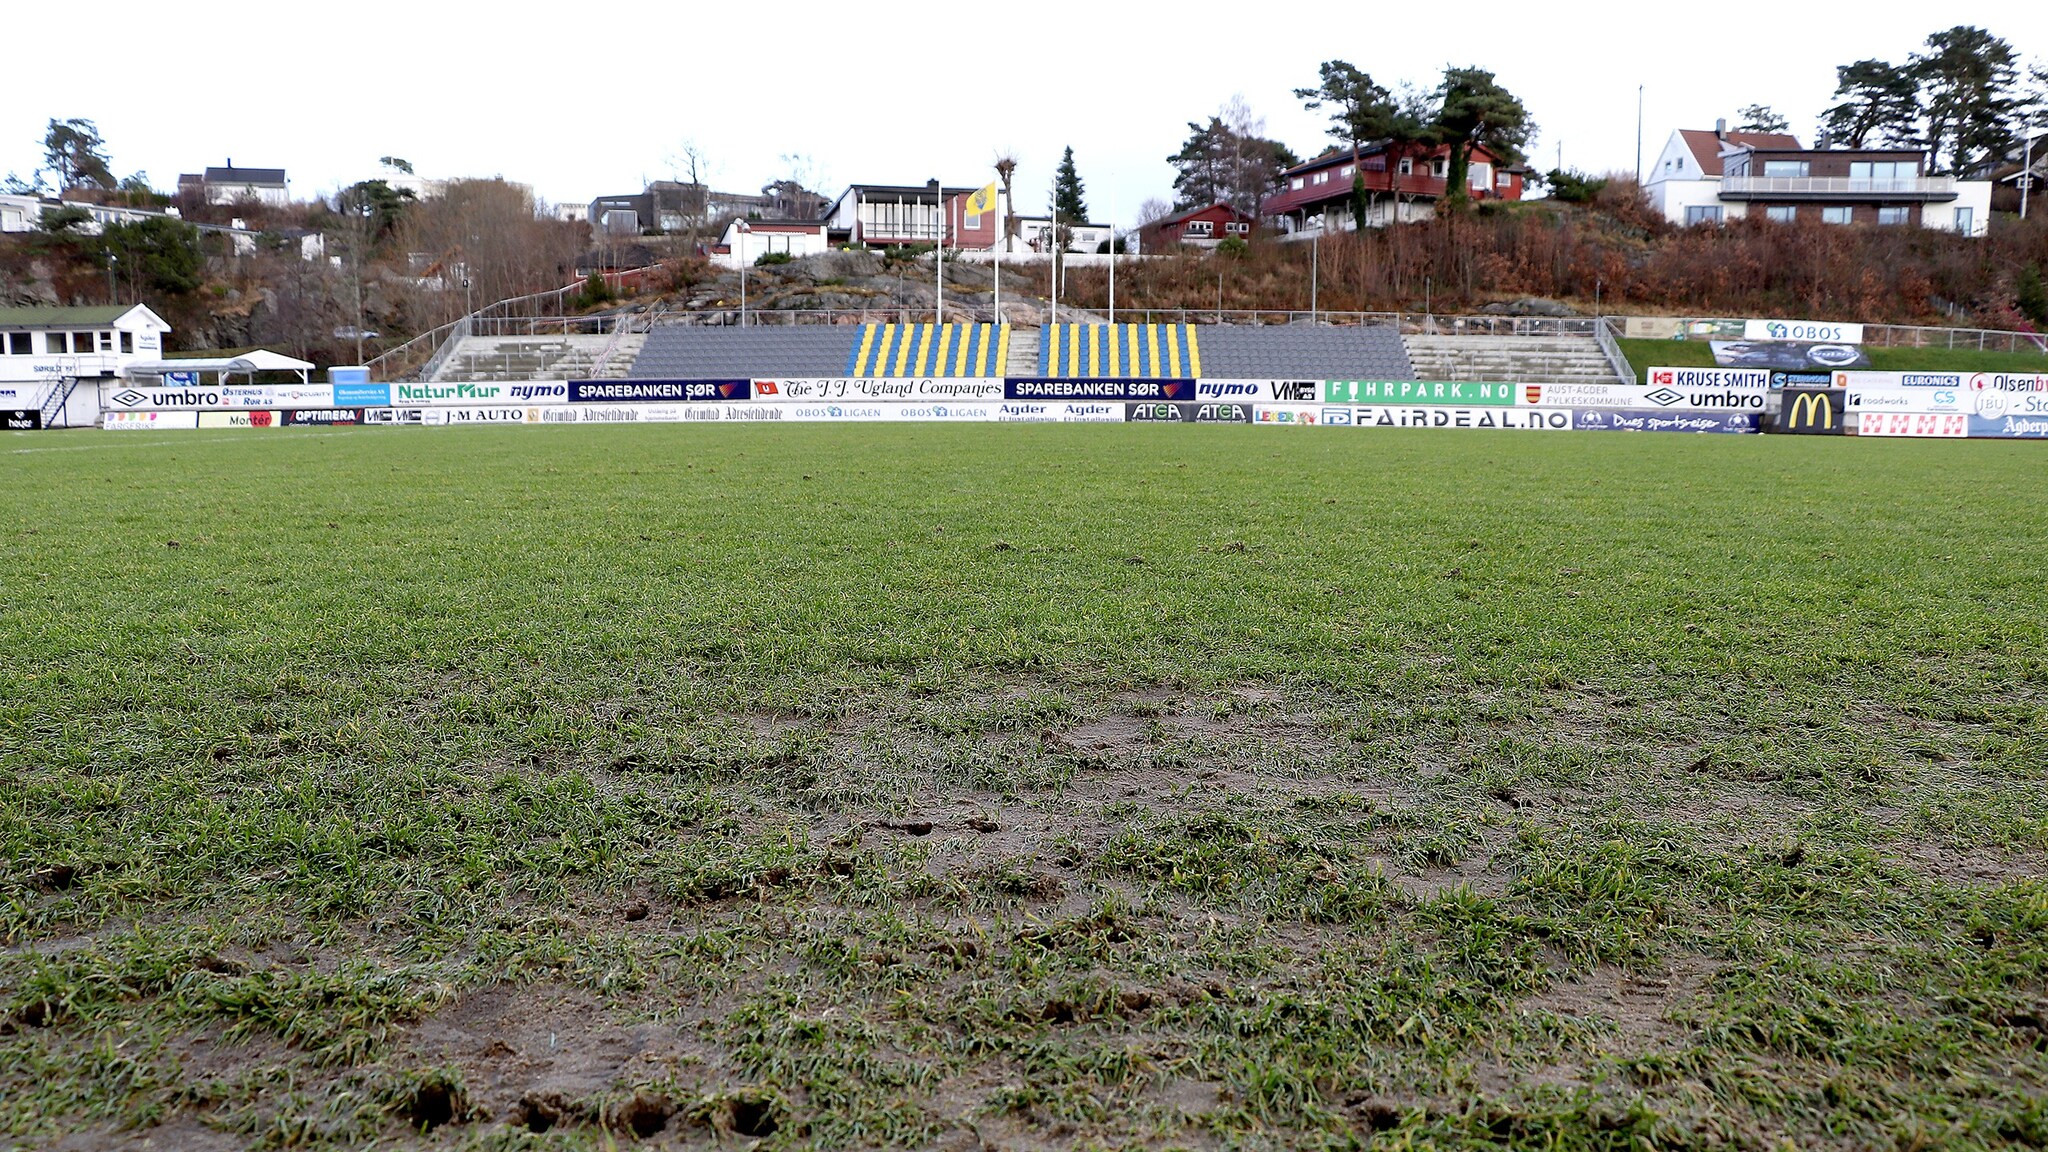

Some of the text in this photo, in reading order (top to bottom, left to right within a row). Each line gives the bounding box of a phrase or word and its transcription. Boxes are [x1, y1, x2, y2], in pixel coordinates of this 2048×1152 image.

[1793, 326, 1841, 340] OBOS
[1677, 371, 1767, 388] KRUSE SMITH
[1904, 375, 1958, 386] EURONICS
[1993, 375, 2048, 392] Olsenb
[222, 387, 263, 396] ØSTERHUS
[398, 384, 500, 399] NaturMur
[510, 384, 566, 401] nymo
[578, 384, 716, 398] SPAREBANKEN SØR
[783, 380, 1002, 398] The J. J. Ugland Companies
[1016, 382, 1159, 396] SPAREBANKEN SØR
[1198, 383, 1259, 399] nymo
[1332, 381, 1510, 402] FHRPARK.NO
[1547, 386, 1609, 394] AUST-AGDER
[152, 389, 219, 406] umbro
[1546, 396, 1633, 406] FYLKESKOMMUNE
[1690, 390, 1764, 408] umbro
[1864, 396, 1908, 405] roadworks
[295, 409, 357, 421] OPTIMERA
[475, 409, 523, 421] AUTO
[796, 408, 881, 417] OBOS LIGAEN
[901, 408, 987, 417] OBOS LIGAEN
[998, 404, 1048, 416] Agder
[1064, 404, 1113, 416] Agder
[1132, 403, 1182, 418] ATEA
[1196, 404, 1246, 419] ATEA
[1255, 408, 1294, 423] LEKER
[229, 414, 269, 425] Montér
[1613, 412, 1645, 428] Dues
[1648, 414, 1721, 432] sportsreiser
